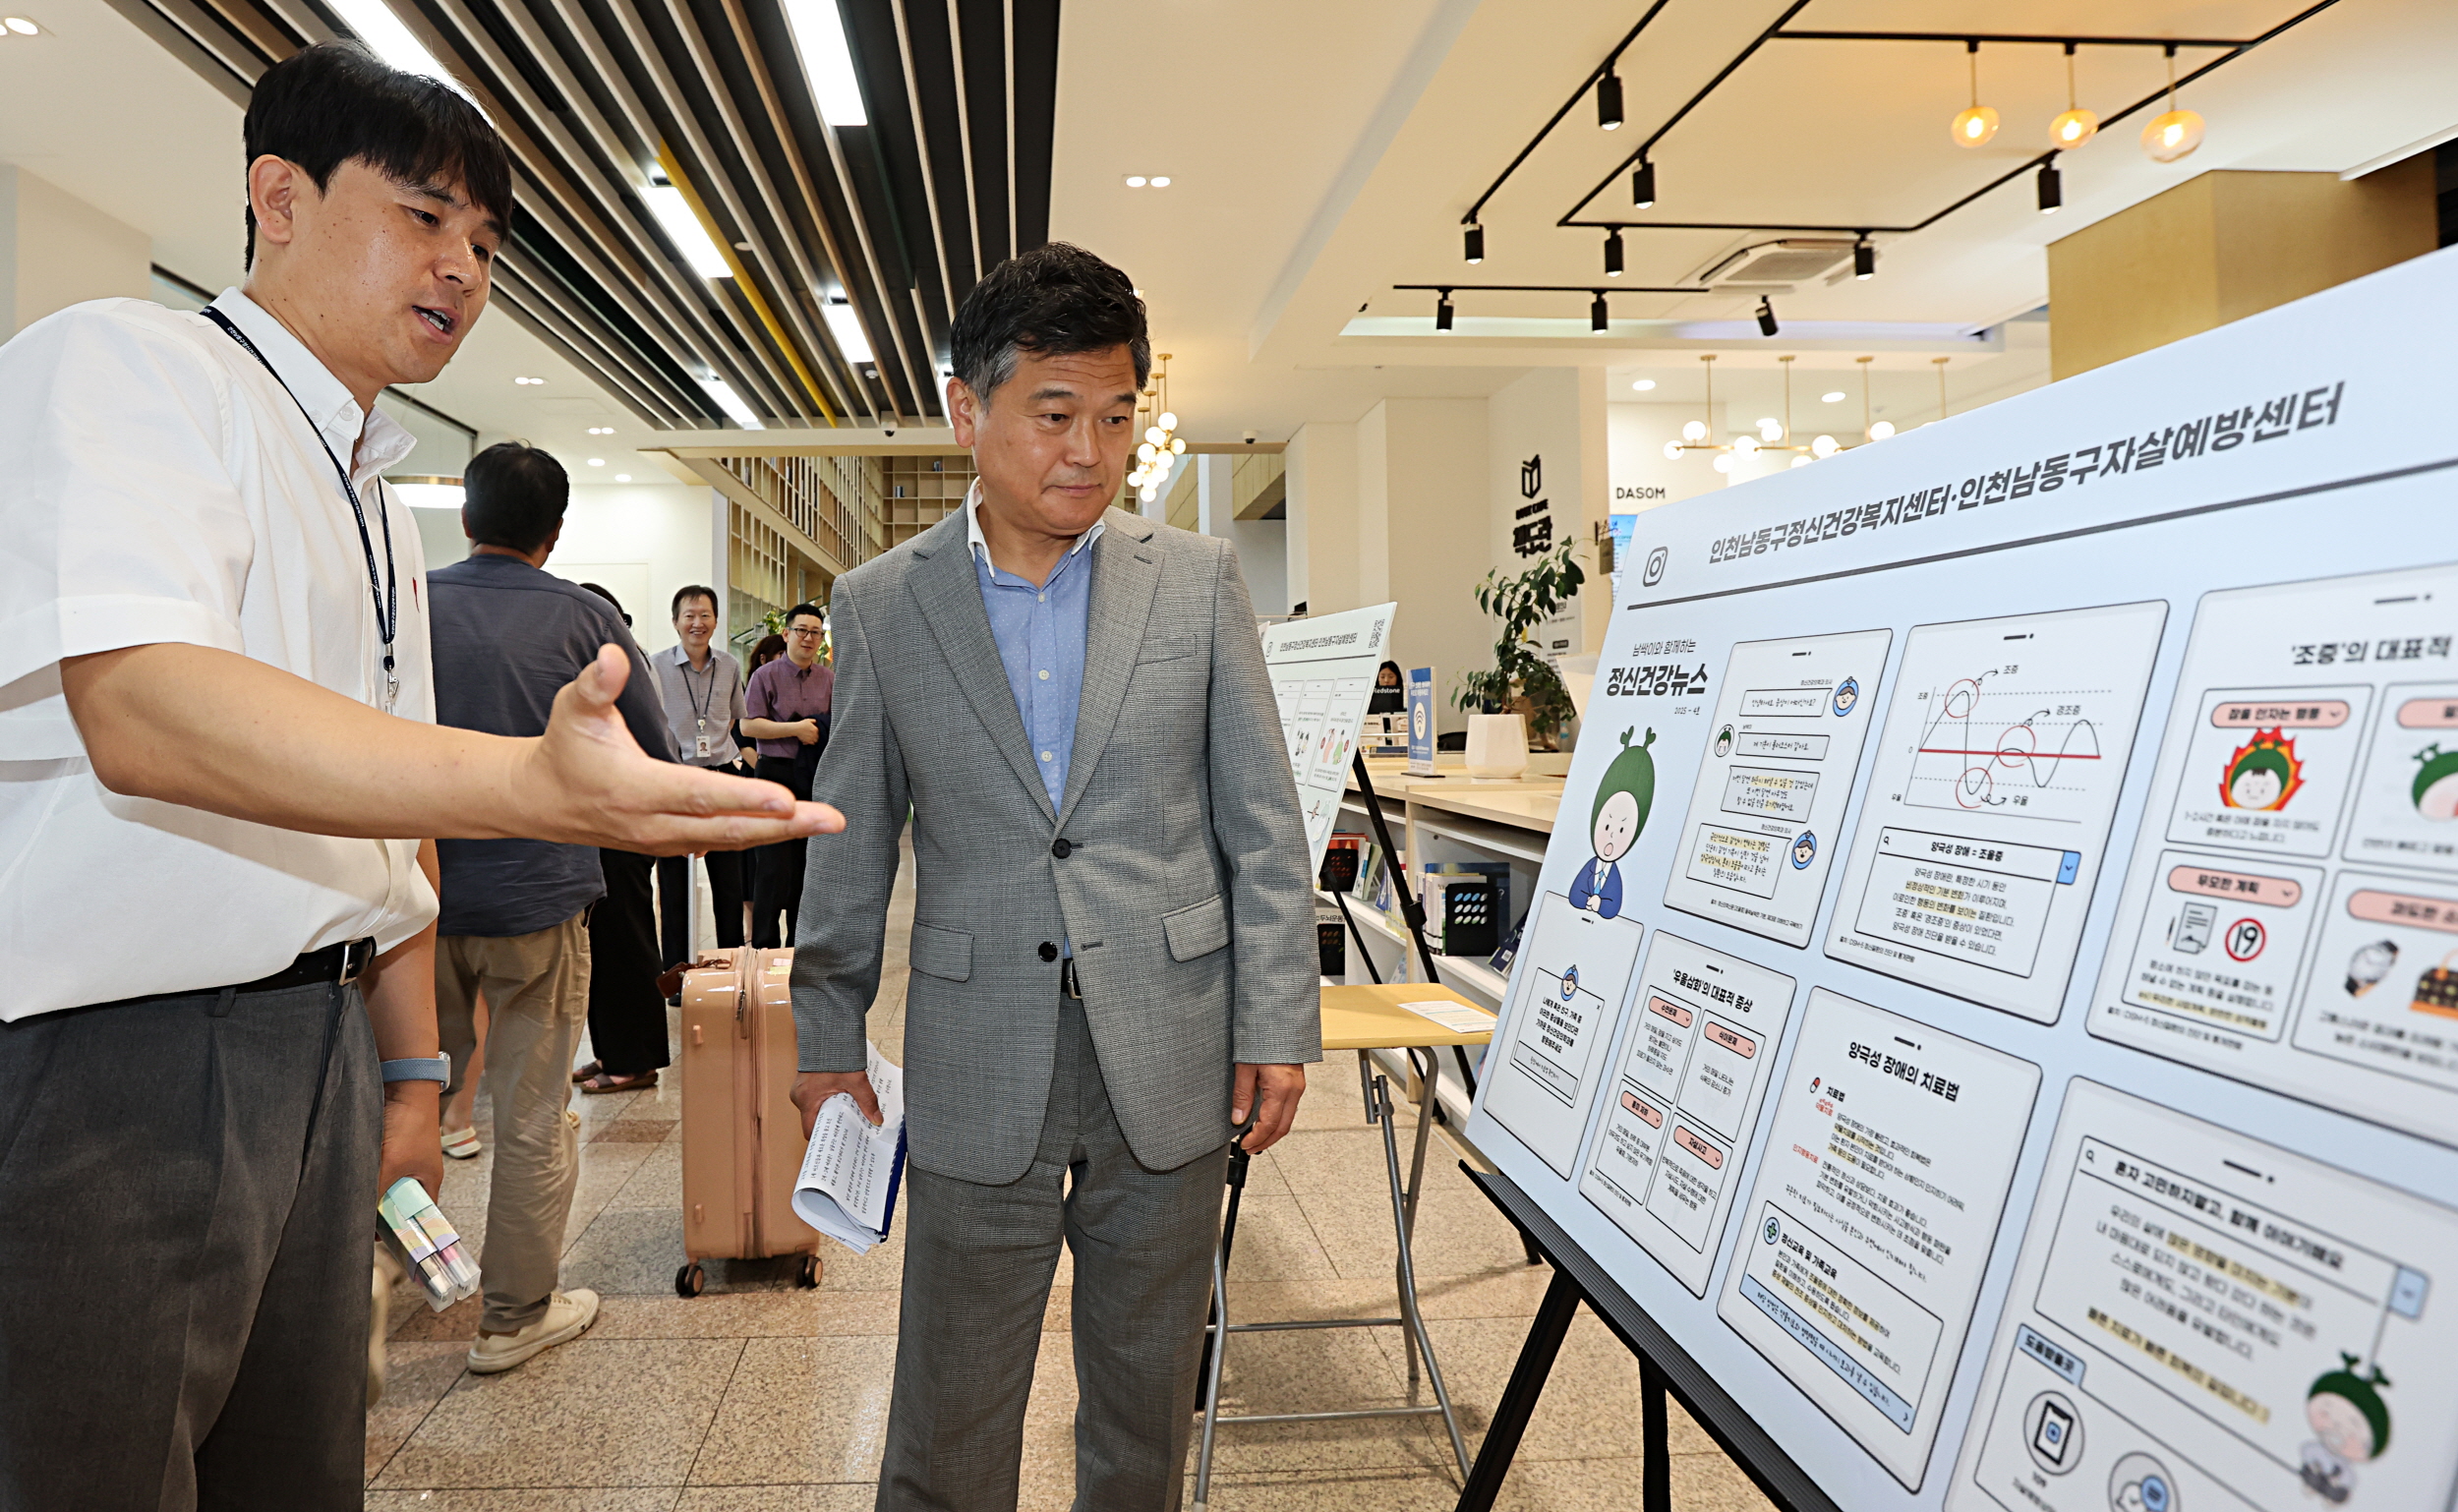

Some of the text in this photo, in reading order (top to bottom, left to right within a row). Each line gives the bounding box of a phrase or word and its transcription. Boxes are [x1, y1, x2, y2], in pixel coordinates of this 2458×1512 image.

[1616, 488, 1666, 499] DASOM
[1664, 639, 1696, 655] 함께하는
[1607, 664, 1708, 696] 정신건강뉴스
[1930, 841, 1953, 854] 양극성
[1954, 844, 1970, 856] 장애
[1978, 848, 2003, 861] 조울증
[2234, 925, 2259, 954] 19
[1672, 969, 1752, 1013] '우울삽화'의 대표적 증상
[1848, 1041, 1959, 1101] 양극성 장애의 치료법
